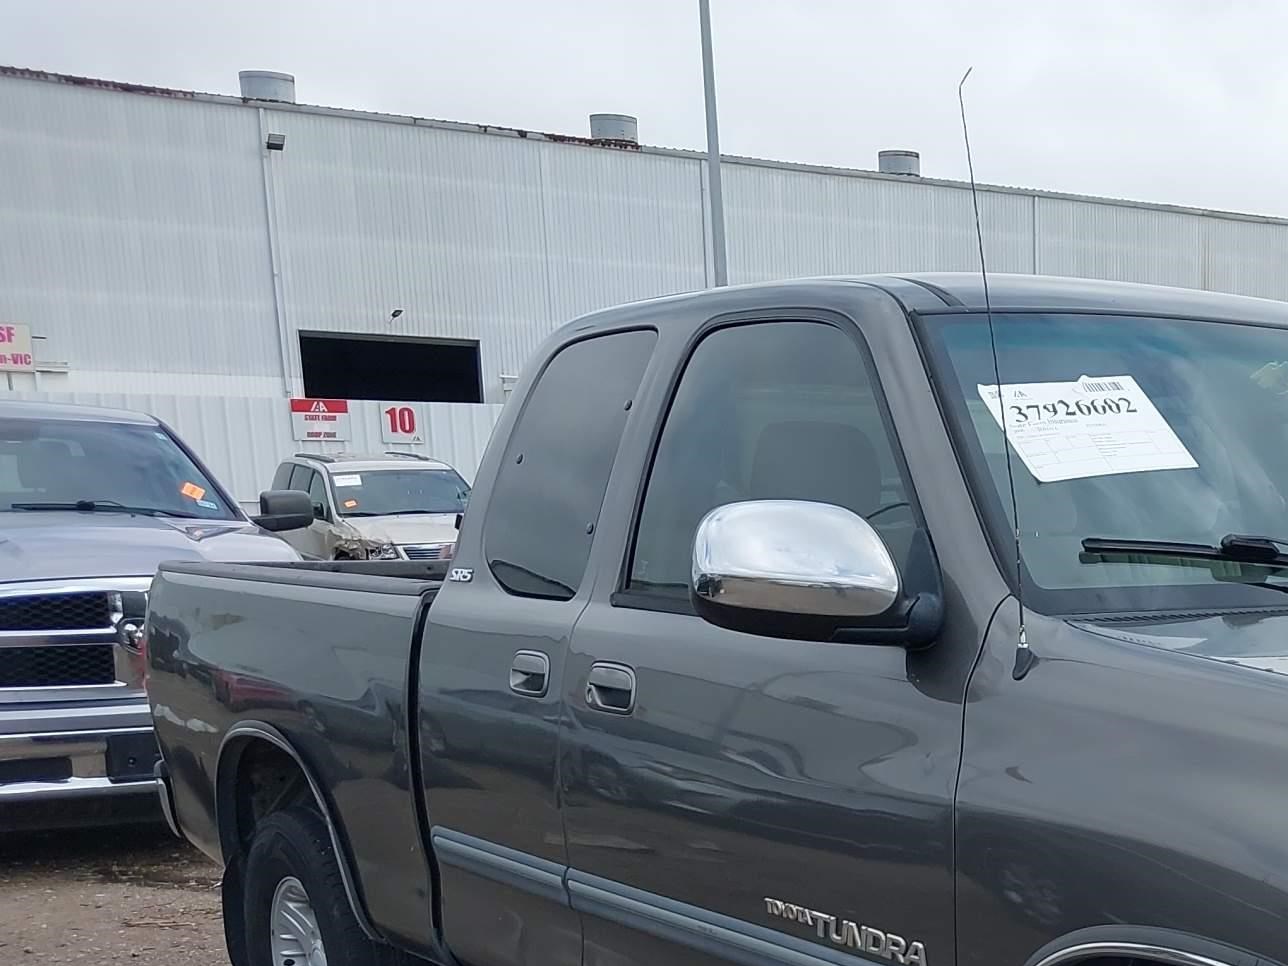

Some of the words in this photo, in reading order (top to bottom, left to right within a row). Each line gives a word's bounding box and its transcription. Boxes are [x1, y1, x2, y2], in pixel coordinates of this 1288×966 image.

[385, 407, 416, 434] 10
[1009, 397, 1137, 423] 37926602
[449, 568, 473, 582] SR5
[764, 897, 813, 926] TOYOTA
